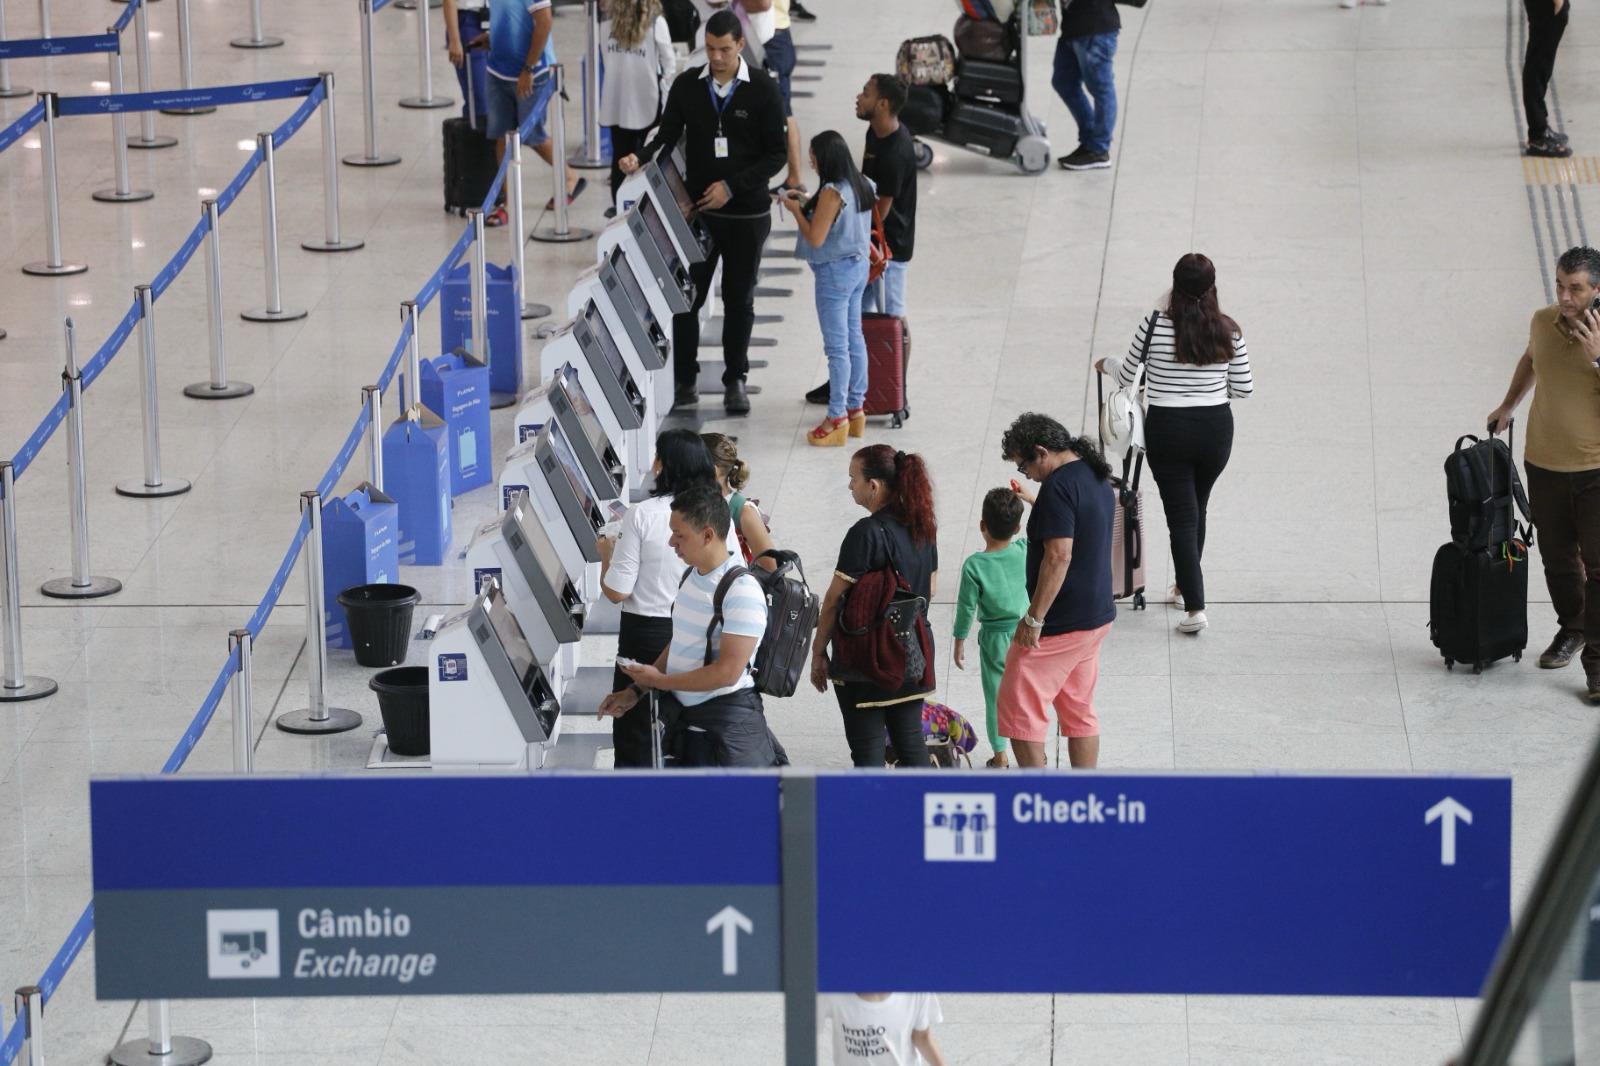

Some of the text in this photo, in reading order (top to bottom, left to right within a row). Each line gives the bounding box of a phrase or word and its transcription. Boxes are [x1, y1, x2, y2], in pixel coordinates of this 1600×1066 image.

[1012, 792, 1146, 824] Check-in
[298, 907, 411, 939] Câmbio
[294, 948, 437, 983] Exchange
[842, 1023, 886, 1037] Irmão
[844, 1036, 879, 1047] mais
